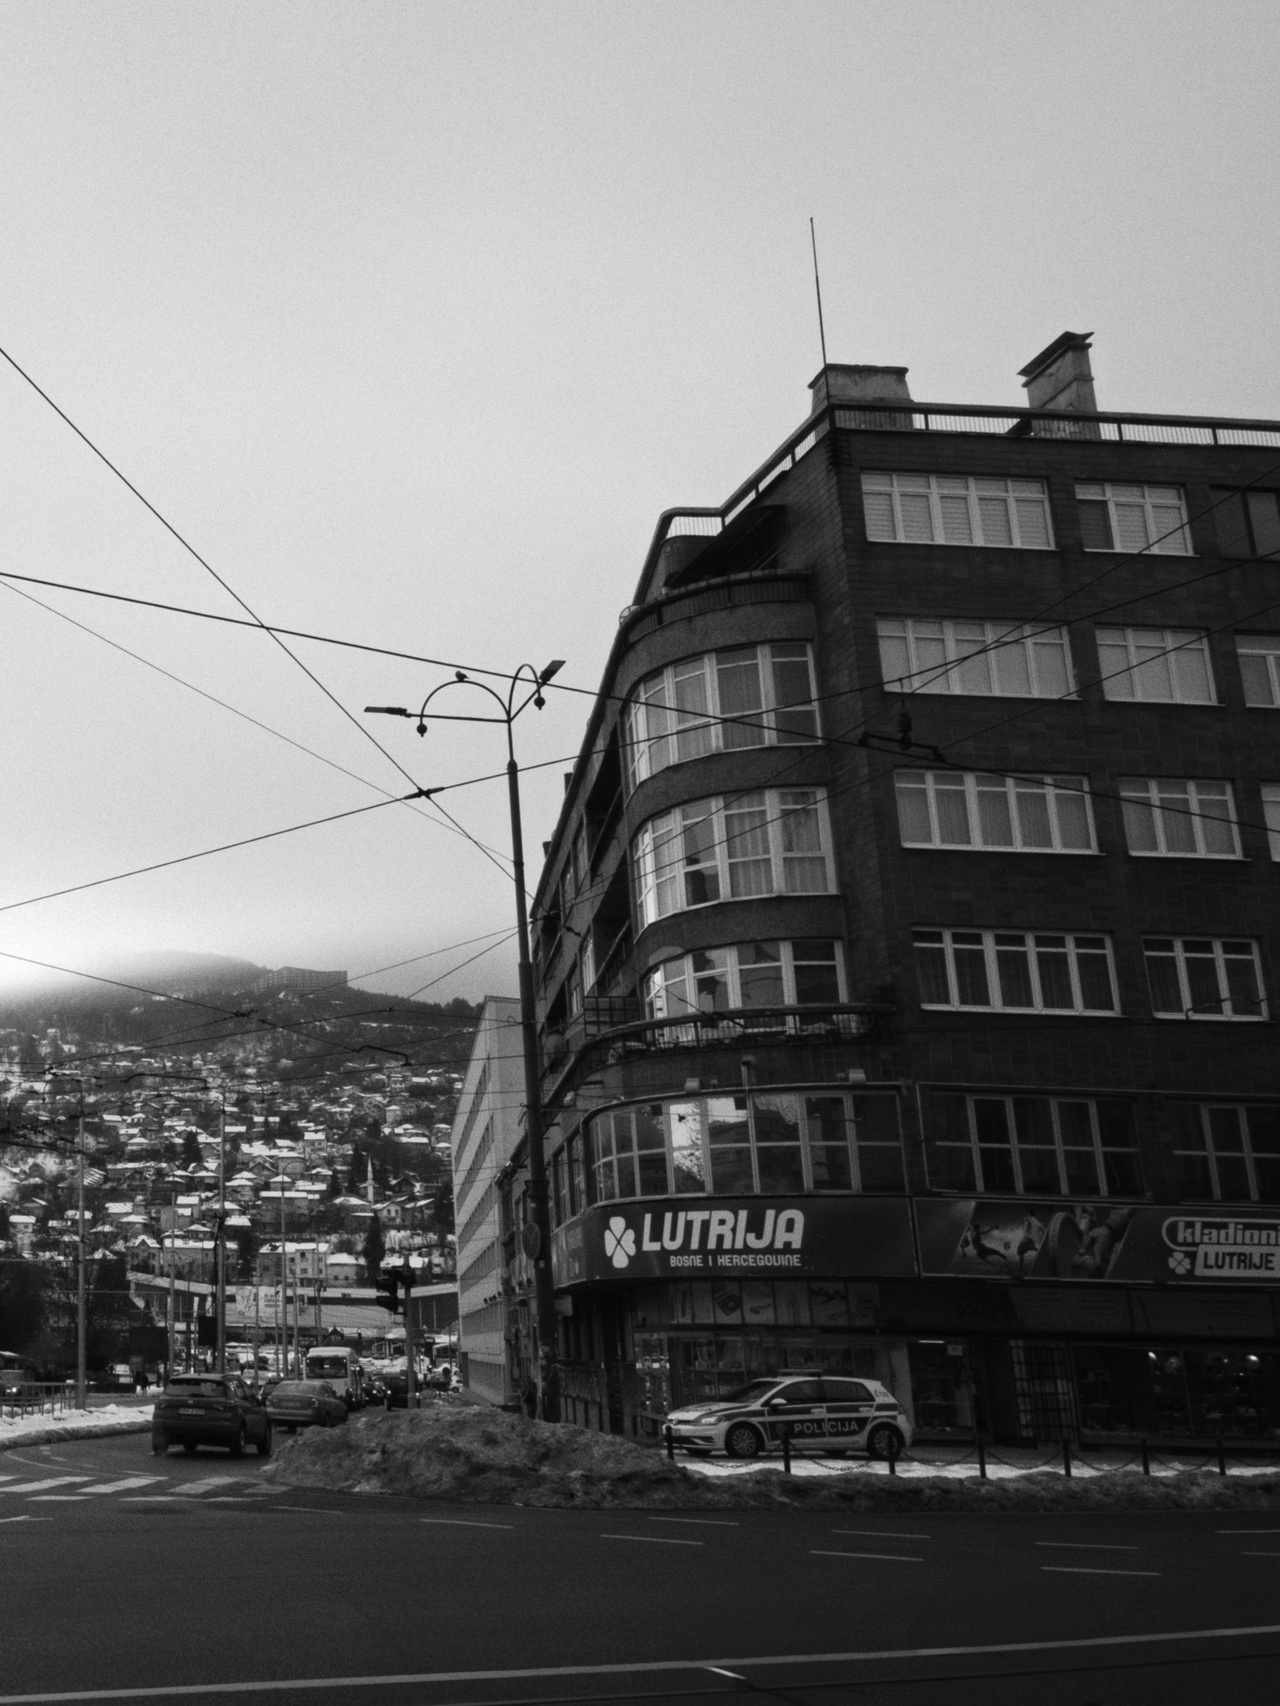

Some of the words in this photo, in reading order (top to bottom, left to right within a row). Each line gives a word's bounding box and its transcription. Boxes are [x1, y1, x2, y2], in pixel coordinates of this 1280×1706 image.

[641, 1208, 805, 1251] LUTRIJA
[1203, 1251, 1275, 1271] LUTRIJE
[793, 1420, 860, 1434] POLICIJA
